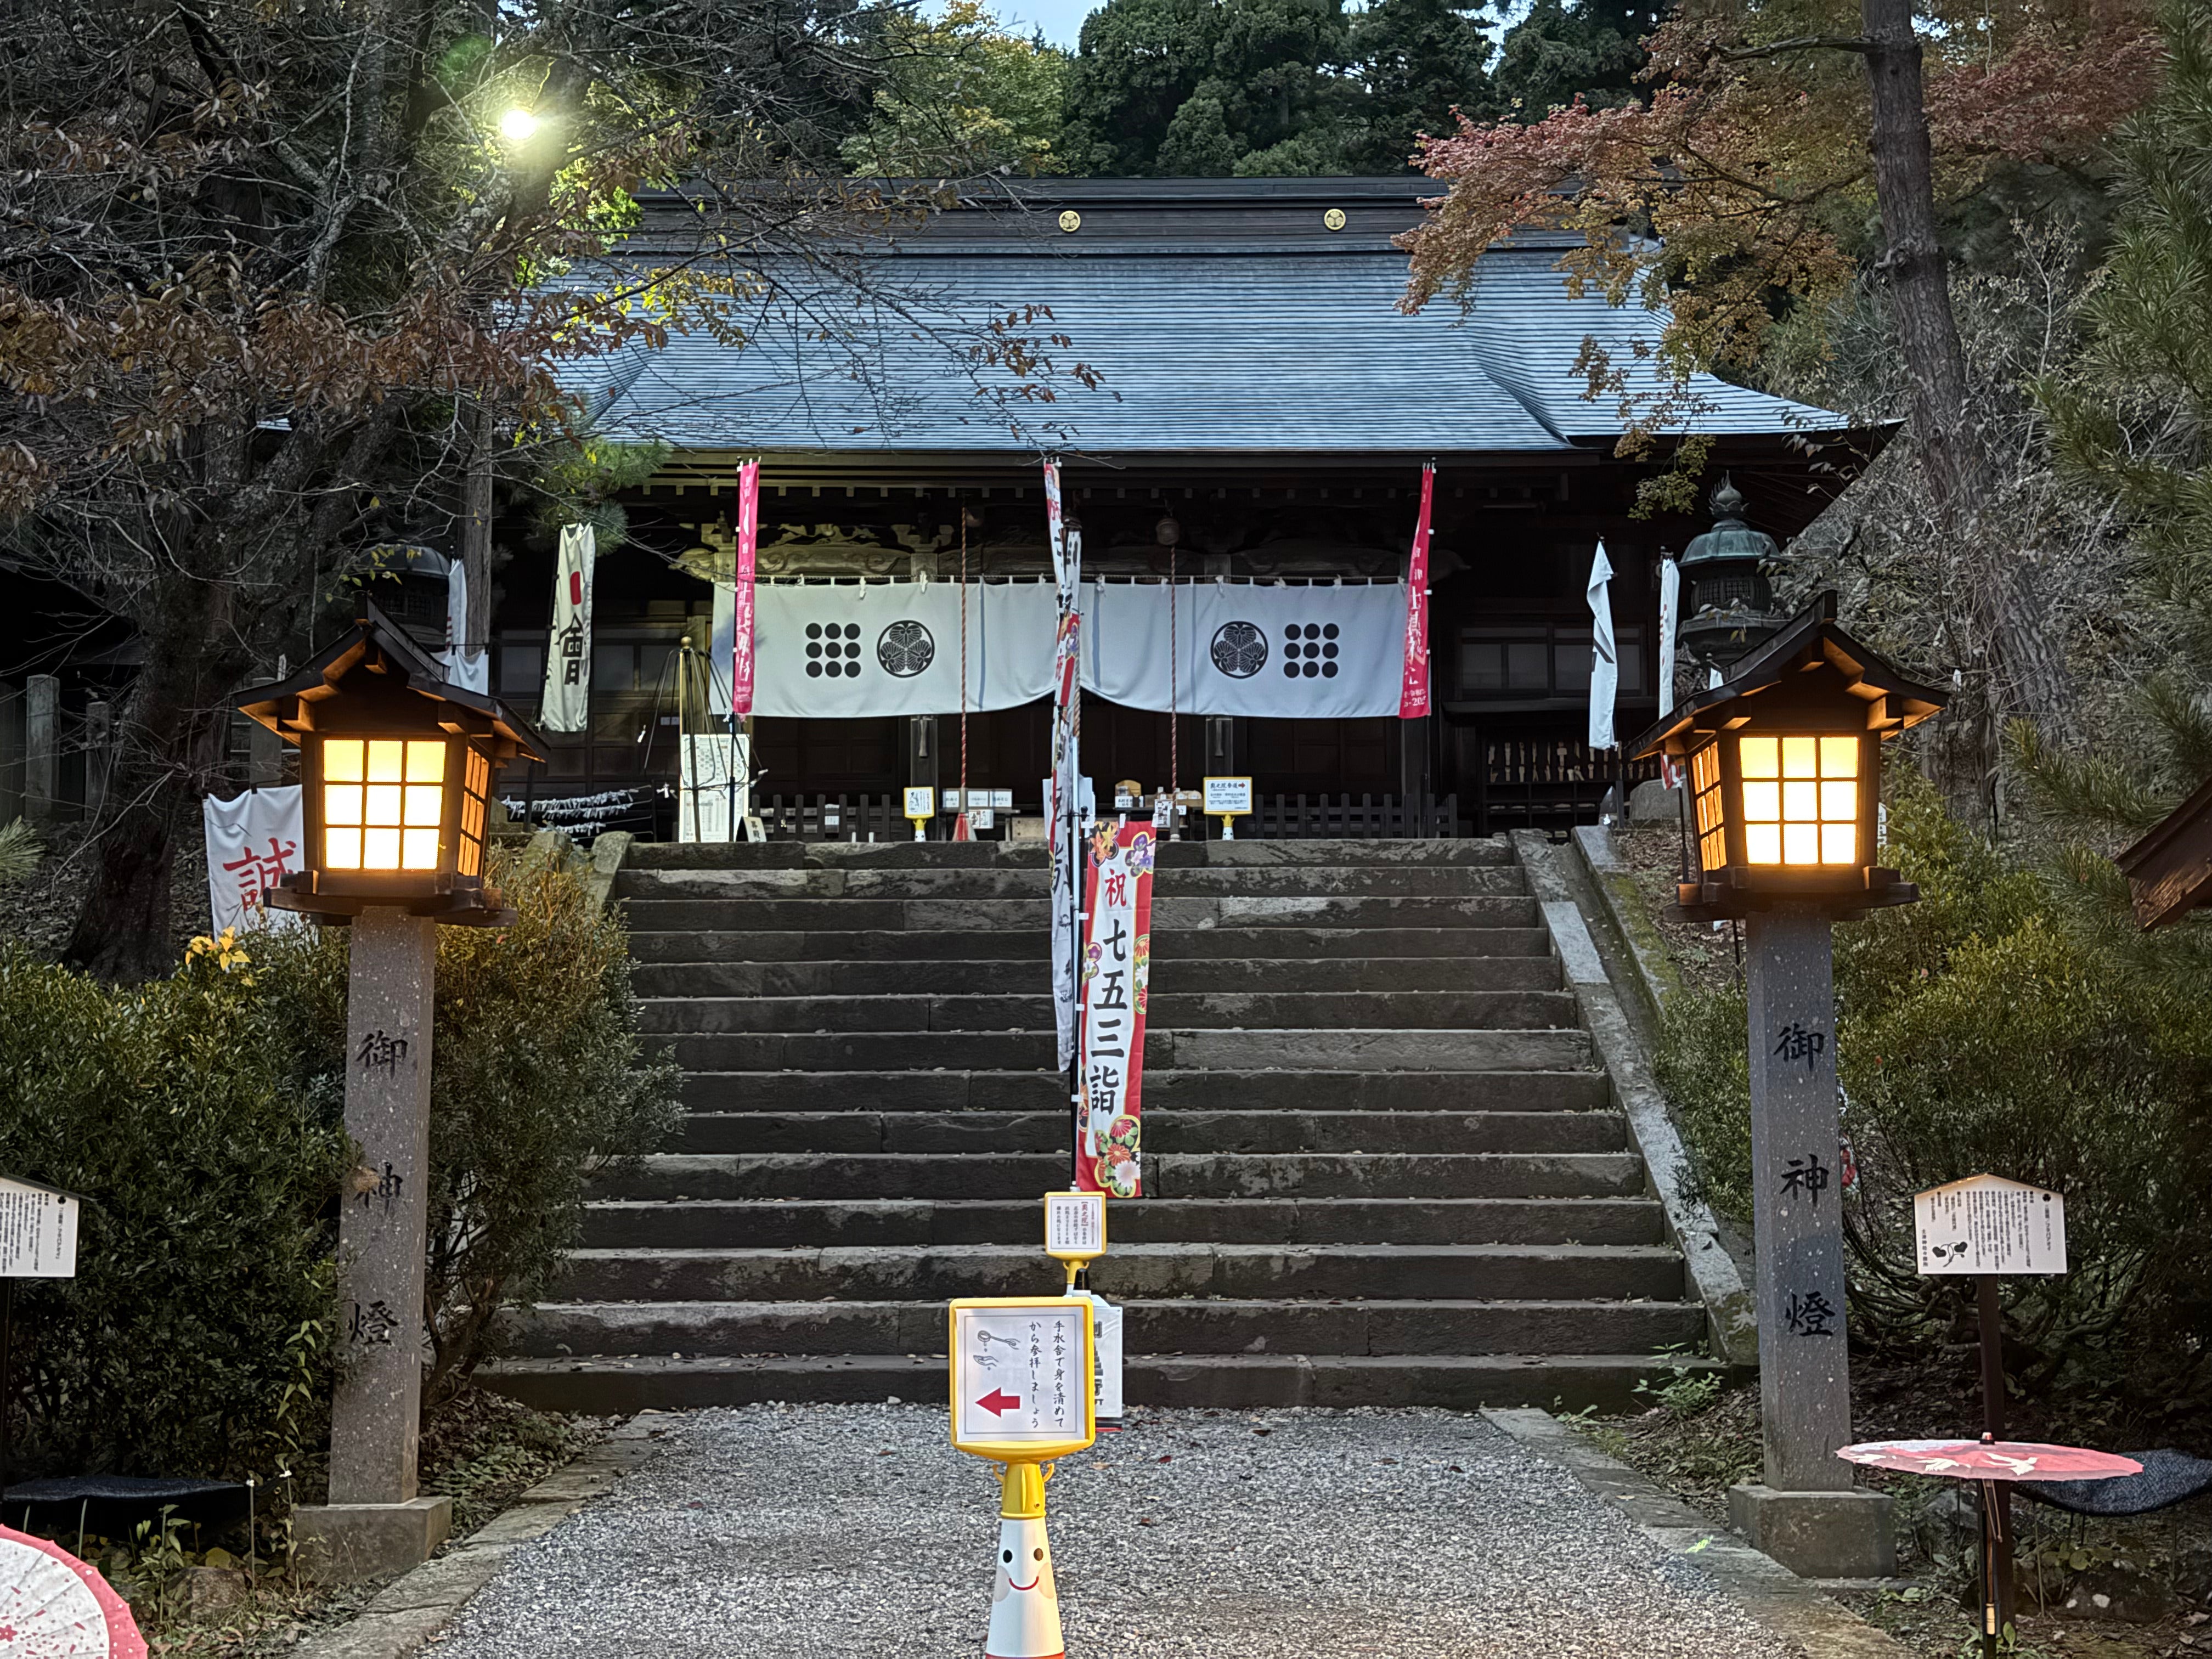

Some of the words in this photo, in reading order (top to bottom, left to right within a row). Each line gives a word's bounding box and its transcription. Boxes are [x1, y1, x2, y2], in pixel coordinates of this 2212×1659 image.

[223, 837, 297, 911] 誠
[1773, 1023, 1836, 1337] 御神燈
[1029, 1321, 1042, 1429] から参拝しましょう
